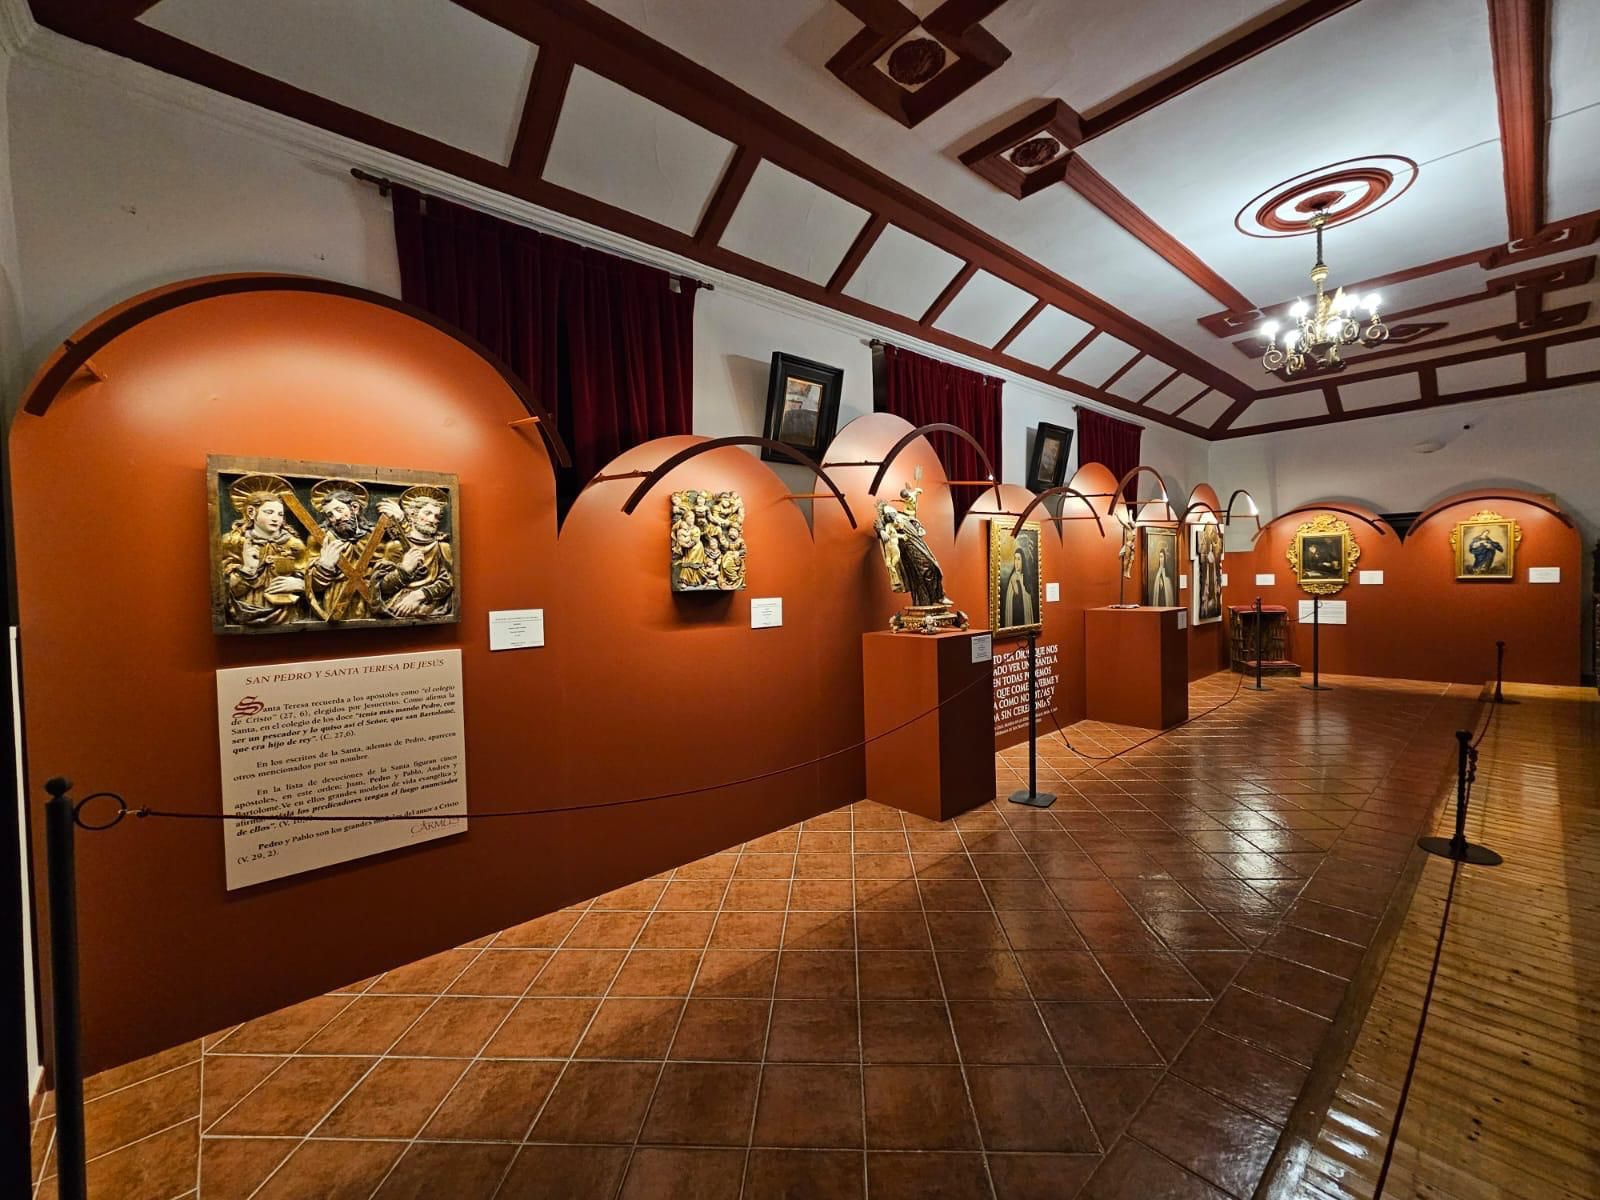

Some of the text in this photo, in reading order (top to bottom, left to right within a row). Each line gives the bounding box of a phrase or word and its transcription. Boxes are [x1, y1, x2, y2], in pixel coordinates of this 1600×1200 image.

[1046, 645, 1058, 654] NOS
[993, 665, 1007, 676] ADO
[1008, 662, 1021, 672] VER
[1035, 656, 1053, 667] SANTA
[246, 676, 270, 685] SAN
[274, 672, 311, 682] PEDRO
[316, 670, 322, 678] Y
[325, 668, 358, 677] SANTA
[364, 664, 399, 673] TERESA
[1003, 673, 1023, 685] TODAS
[996, 687, 1010, 698] QUE
[312, 698, 344, 706] recuerda
[999, 696, 1019, 708] COMO
[314, 707, 345, 715] elegidos
[1001, 709, 1011, 720] SIN
[282, 720, 310, 728] colegio
[263, 730, 300, 741] pescador
[321, 725, 342, 733] quiso
[233, 747, 249, 755] que
[286, 755, 316, 763] escritos
[258, 764, 311, 776] mencionados
[322, 773, 363, 783] devociones
[328, 791, 356, 801] grandes
[360, 784, 389, 793] modelos
[298, 807, 310, 815] los
[312, 798, 361, 813] predicadores
[259, 841, 283, 850] Pedro
[292, 833, 313, 842] Pablo
[344, 819, 372, 832] grandes
